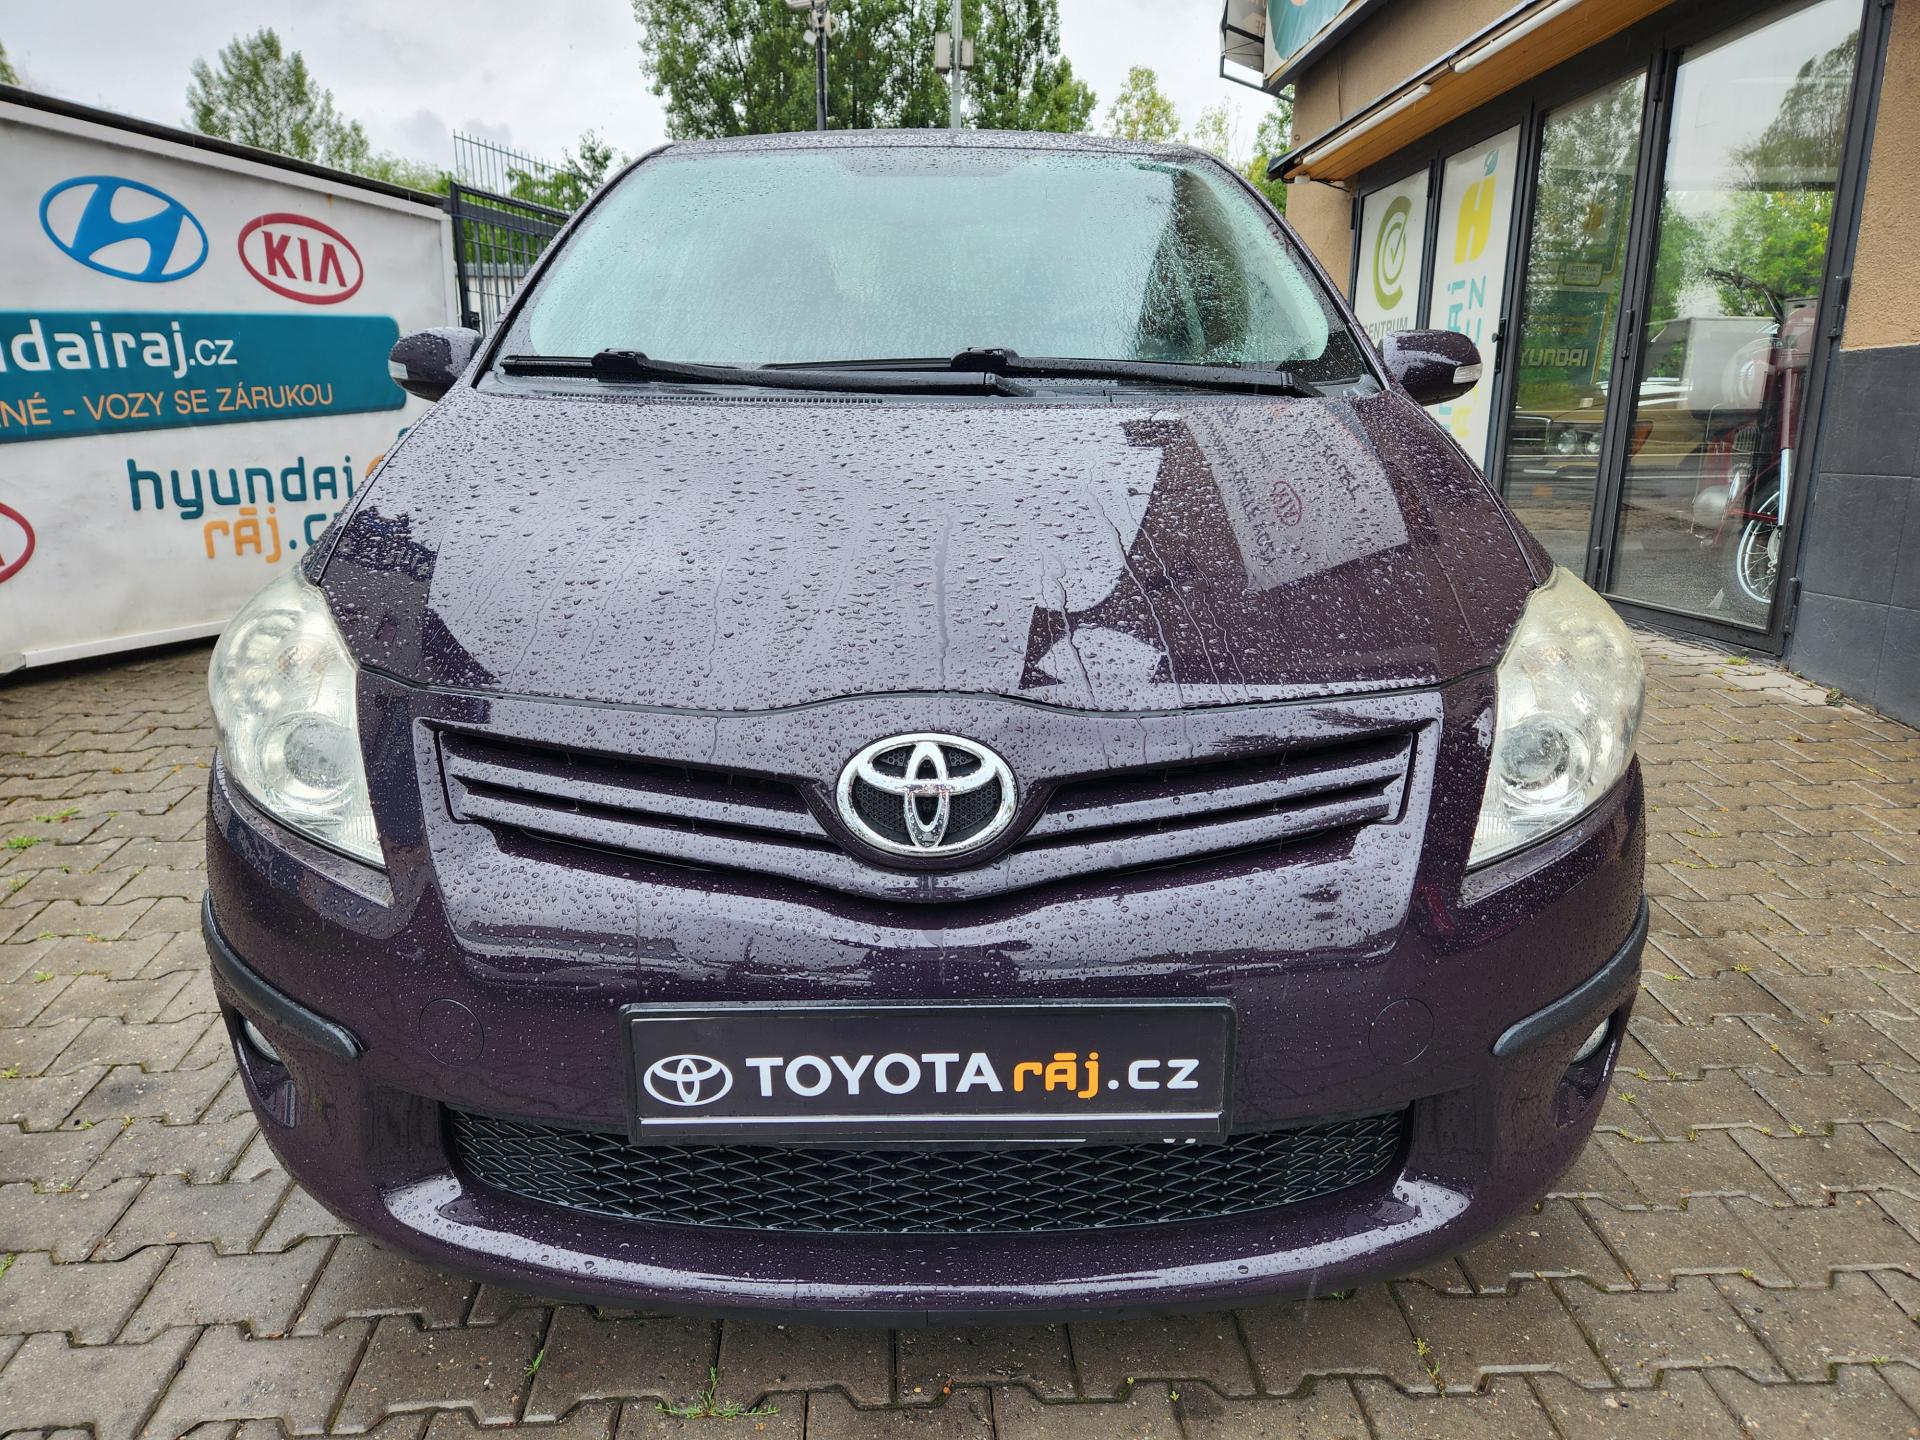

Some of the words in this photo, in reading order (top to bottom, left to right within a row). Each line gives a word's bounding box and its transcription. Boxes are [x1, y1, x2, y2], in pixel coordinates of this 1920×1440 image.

[261, 230, 348, 288] KIA
[0, 318, 238, 379] dairaj.cz
[0, 391, 52, 428] NÉ
[83, 391, 164, 421] VOZY
[173, 389, 210, 415] SE
[216, 381, 333, 411] ZÁRUKOU
